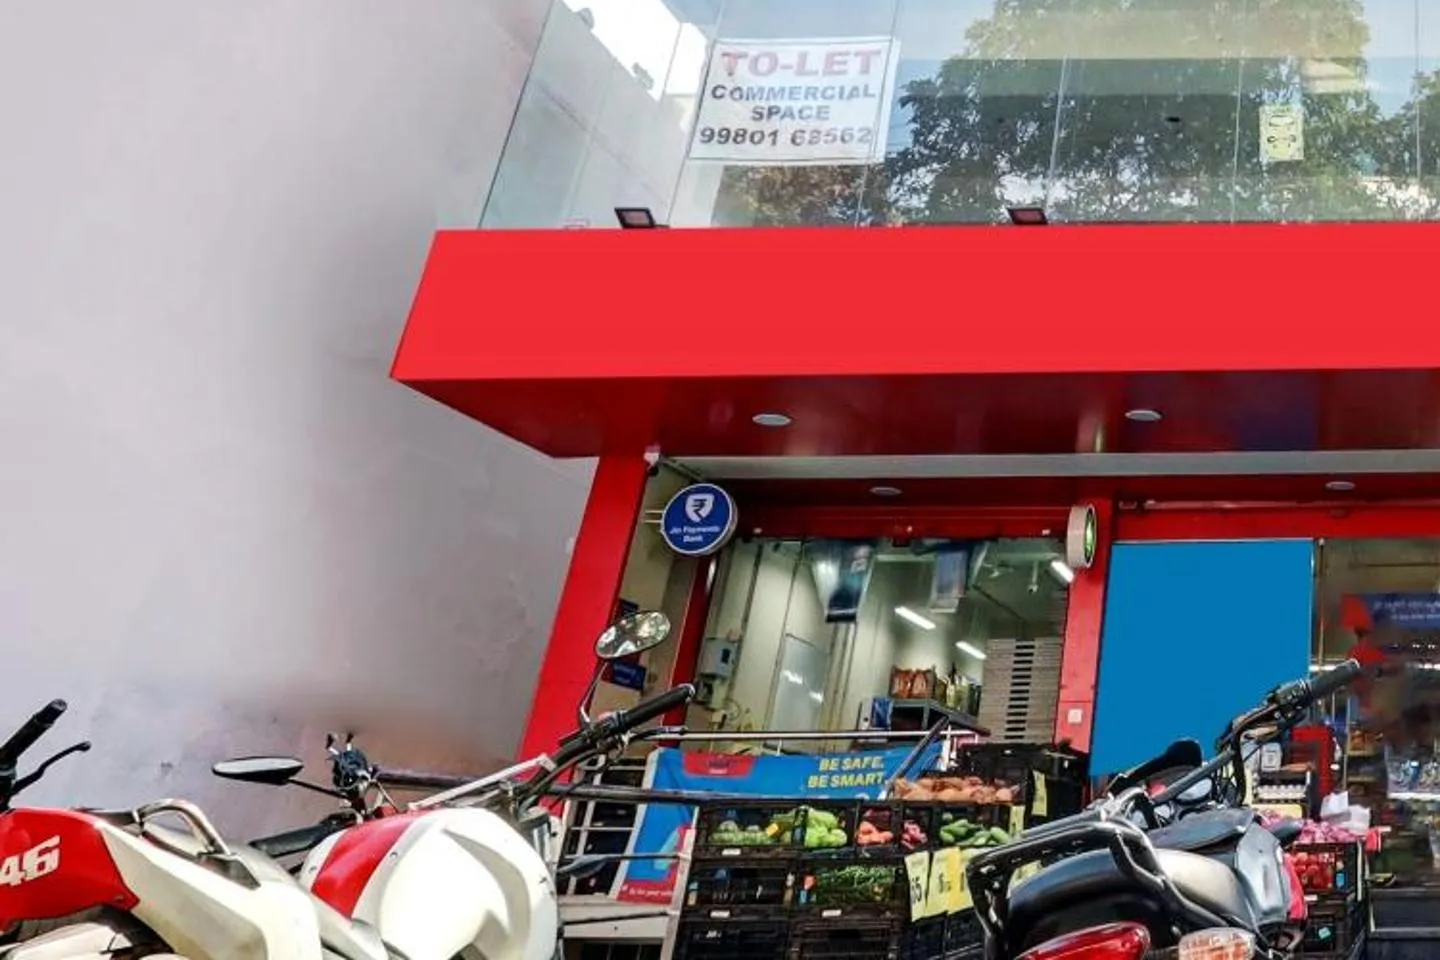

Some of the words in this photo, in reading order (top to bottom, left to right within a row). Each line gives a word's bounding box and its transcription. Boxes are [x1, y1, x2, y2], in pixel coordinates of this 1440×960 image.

[721, 49, 881, 77] TO-LET
[711, 83, 877, 102] COMMERCIAL
[751, 104, 831, 123] SPACE
[700, 126, 778, 147] 99801
[819, 757, 840, 772] BE
[807, 774, 829, 789] BE
